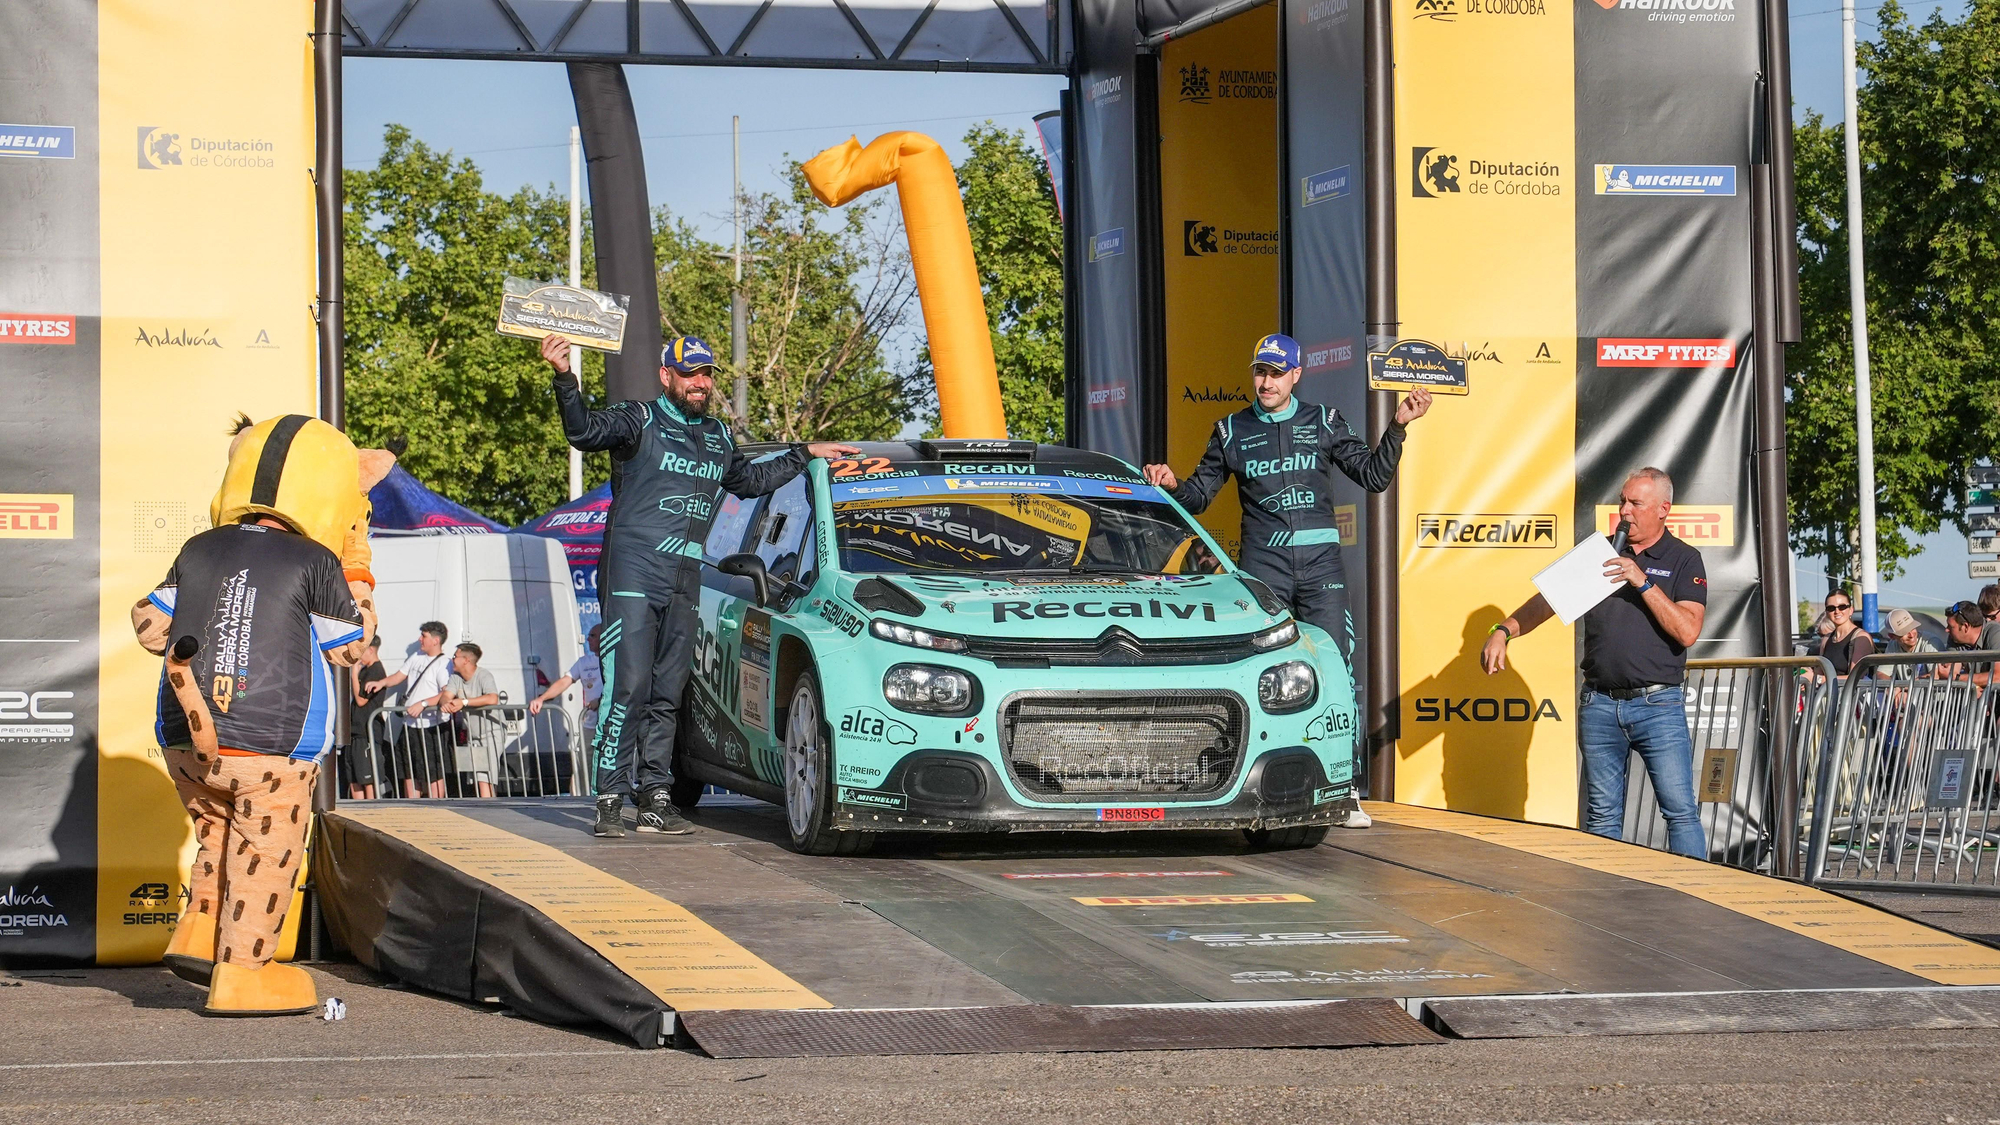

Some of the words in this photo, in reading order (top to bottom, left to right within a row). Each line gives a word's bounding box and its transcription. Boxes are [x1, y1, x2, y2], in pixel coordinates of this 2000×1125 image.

[1467, 0, 1481, 13] DE
[1648, 12, 1686, 24] driving
[1689, 12, 1735, 22] emotion
[1219, 85, 1230, 97] DE
[191, 138, 273, 153] Diputación
[190, 155, 207, 166] de
[213, 154, 274, 168] Córdoba
[1470, 160, 1559, 179] Diputación
[1315, 176, 1346, 194] MICHELIN
[1469, 180, 1489, 194] de
[1494, 180, 1560, 195] Córdoba
[1635, 175, 1723, 187] MICHELIN
[1224, 244, 1237, 254] de
[522, 303, 544, 312] 43
[547, 305, 600, 324] Andalucía
[0, 319, 70, 337] TYRES
[516, 315, 555, 327] SIERRA
[558, 321, 606, 335] MORENA
[135, 326, 223, 349] Andalucía
[1307, 349, 1327, 368] MRF
[1329, 345, 1351, 364] TYRES
[1601, 345, 1664, 360] MRF
[1667, 345, 1731, 361] TYRES
[1385, 357, 1403, 366] 43
[1406, 358, 1448, 372] Andalucía
[1383, 370, 1415, 379] SIERRA
[1416, 373, 1455, 382] MORENA
[1182, 386, 1251, 403] Andalucía
[659, 451, 724, 481] Recalvi
[830, 457, 894, 477] 22
[944, 464, 1036, 475] Recalvi
[1245, 452, 1317, 478] Recalvi
[832, 469, 919, 484] RecOficial
[1063, 469, 1146, 485] RecOficial
[1282, 488, 1315, 506] alca
[1442, 519, 1532, 544] Recalvi
[1973, 566, 1996, 574] GRANADA
[214, 573, 239, 633] Andalucía
[230, 568, 250, 627] MORENA
[992, 598, 1216, 623] Recalvi
[225, 627, 239, 675] SIERRA
[238, 619, 252, 667] CÓRDOBA
[215, 632, 228, 673] RALLY
[212, 675, 234, 714] 43
[841, 710, 884, 736] alca
[1326, 709, 1350, 732] alca
[600, 702, 627, 771] Recalvi
[839, 733, 868, 741] Asistencia
[857, 794, 901, 805] MICHELIN
[1104, 809, 1160, 820] BN80SC
[130, 883, 169, 900] 43
[123, 913, 179, 925] SIERR
